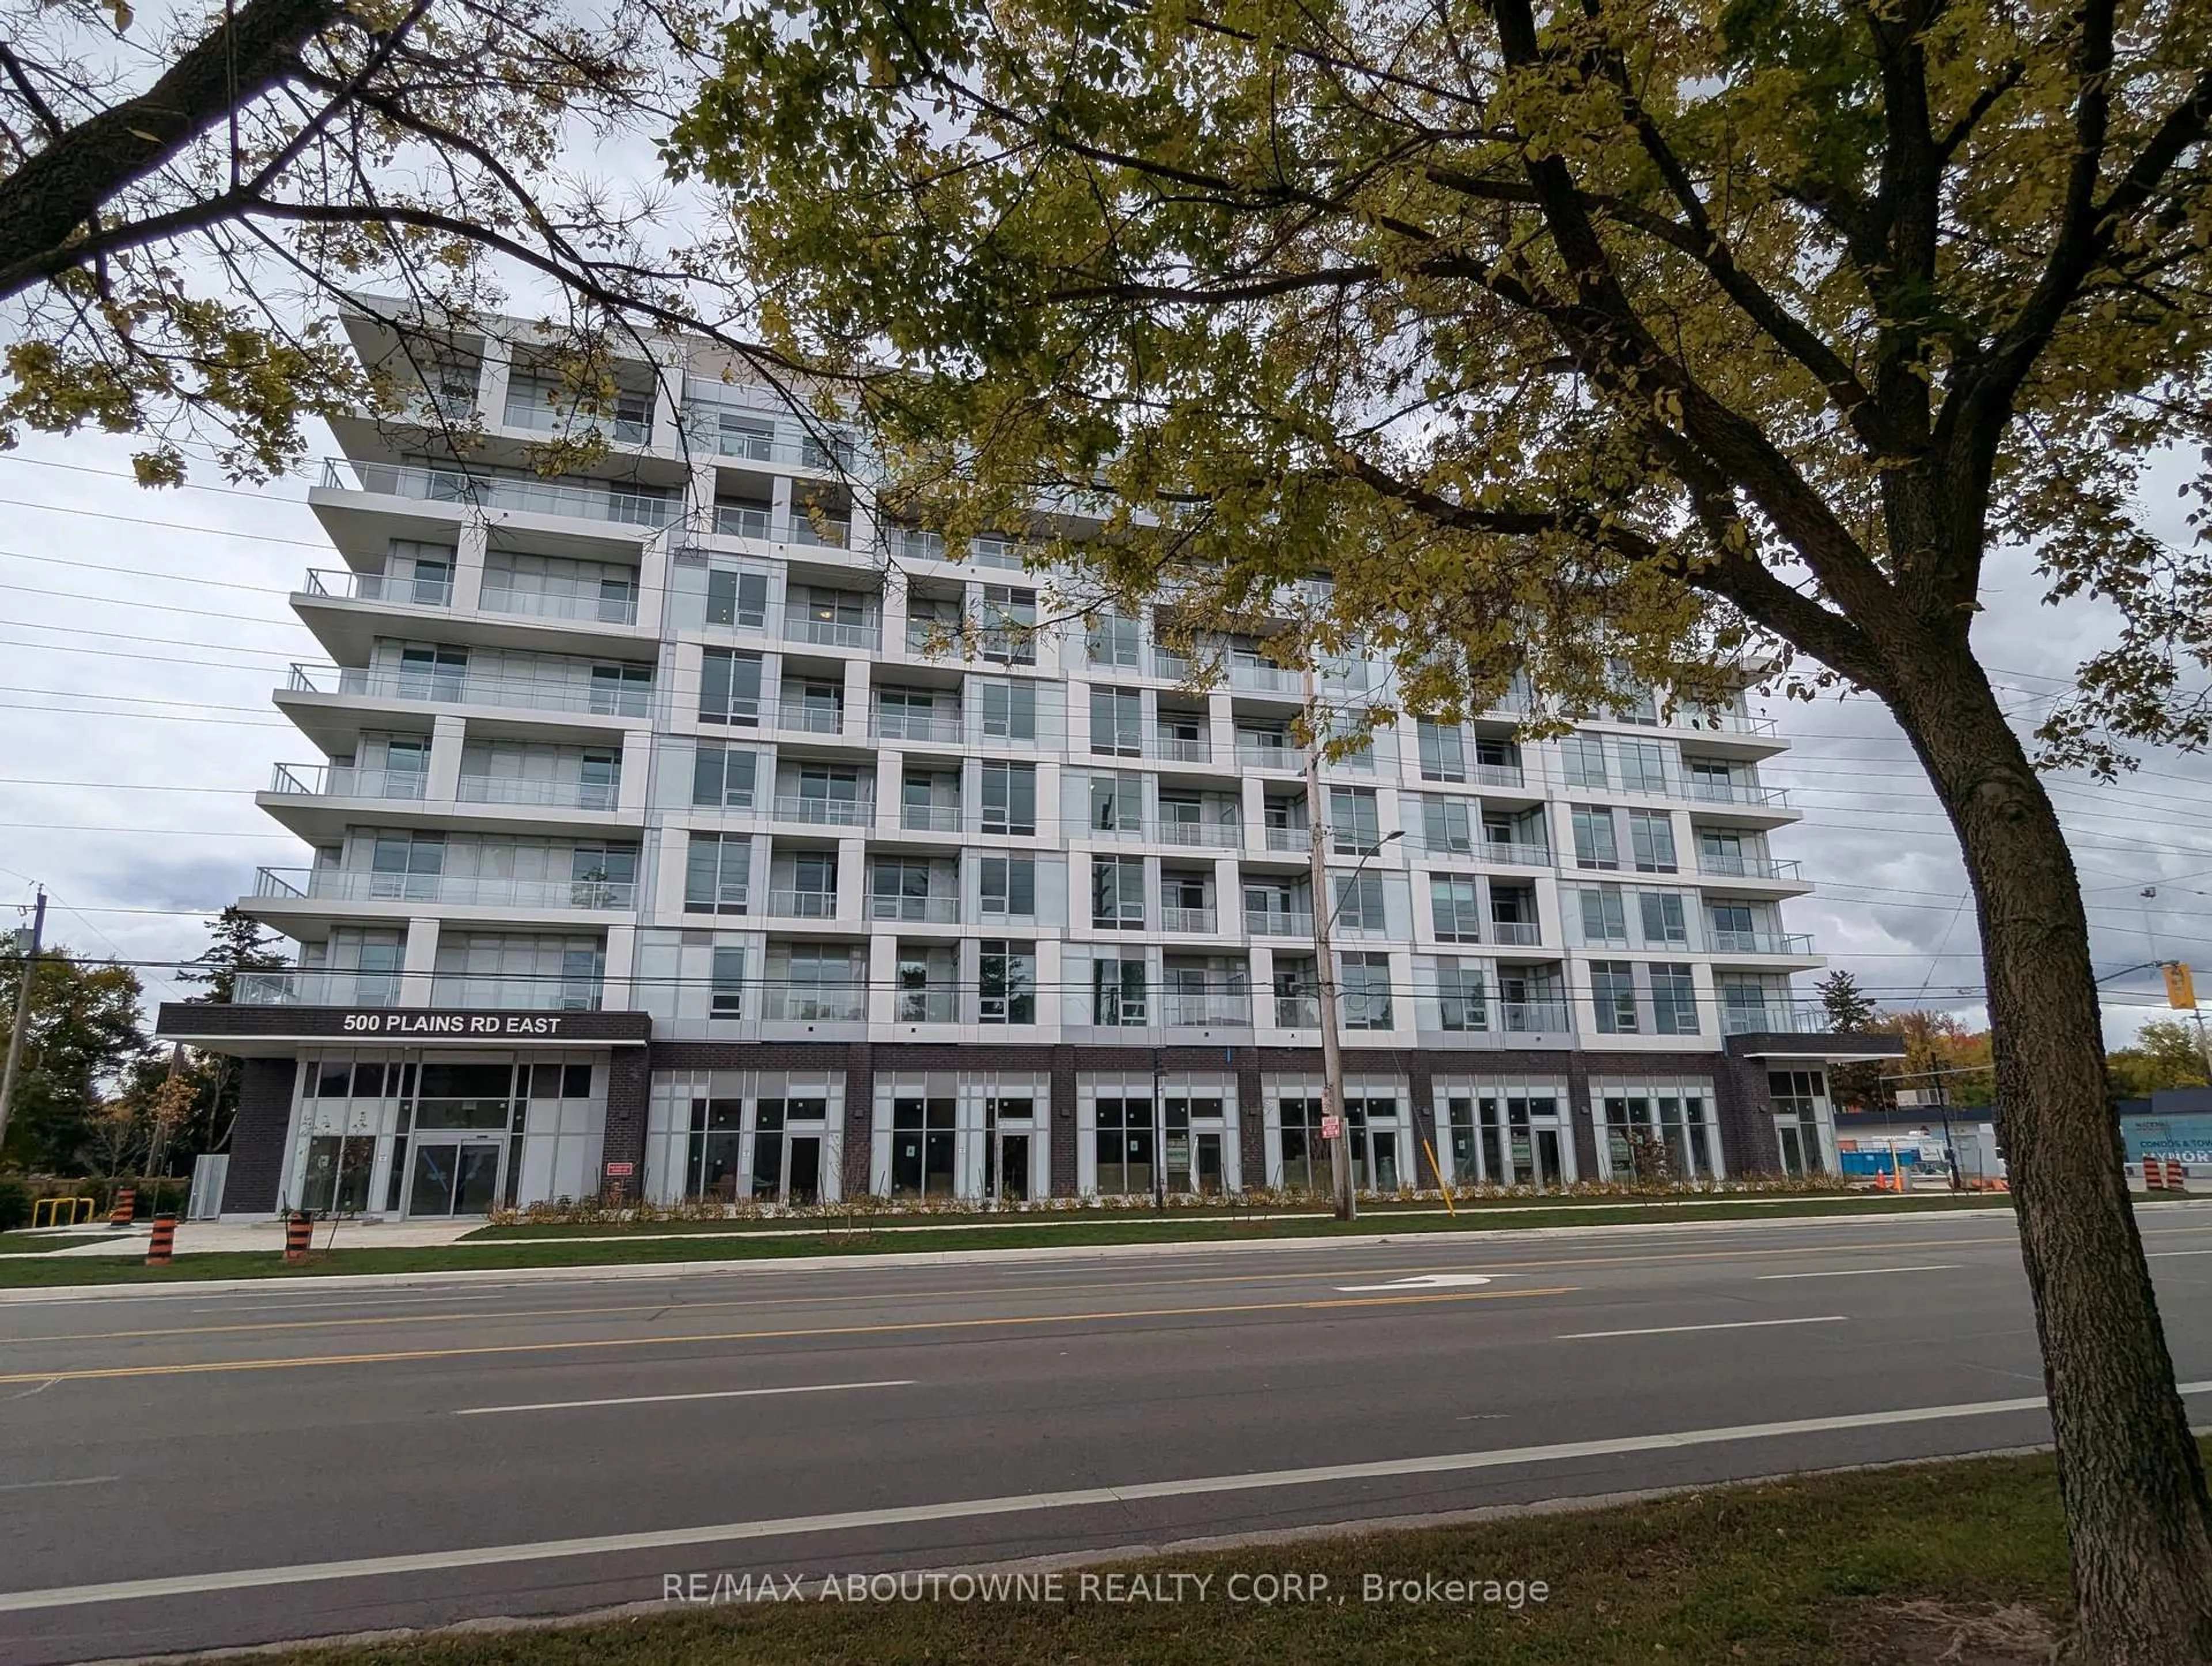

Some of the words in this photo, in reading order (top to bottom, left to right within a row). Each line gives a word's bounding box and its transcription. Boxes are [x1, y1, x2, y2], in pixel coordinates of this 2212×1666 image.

[344, 1015, 380, 1031] 500
[386, 1016, 464, 1032] PLAINS
[470, 1017, 500, 1032] RD
[506, 1017, 561, 1033] EAST
